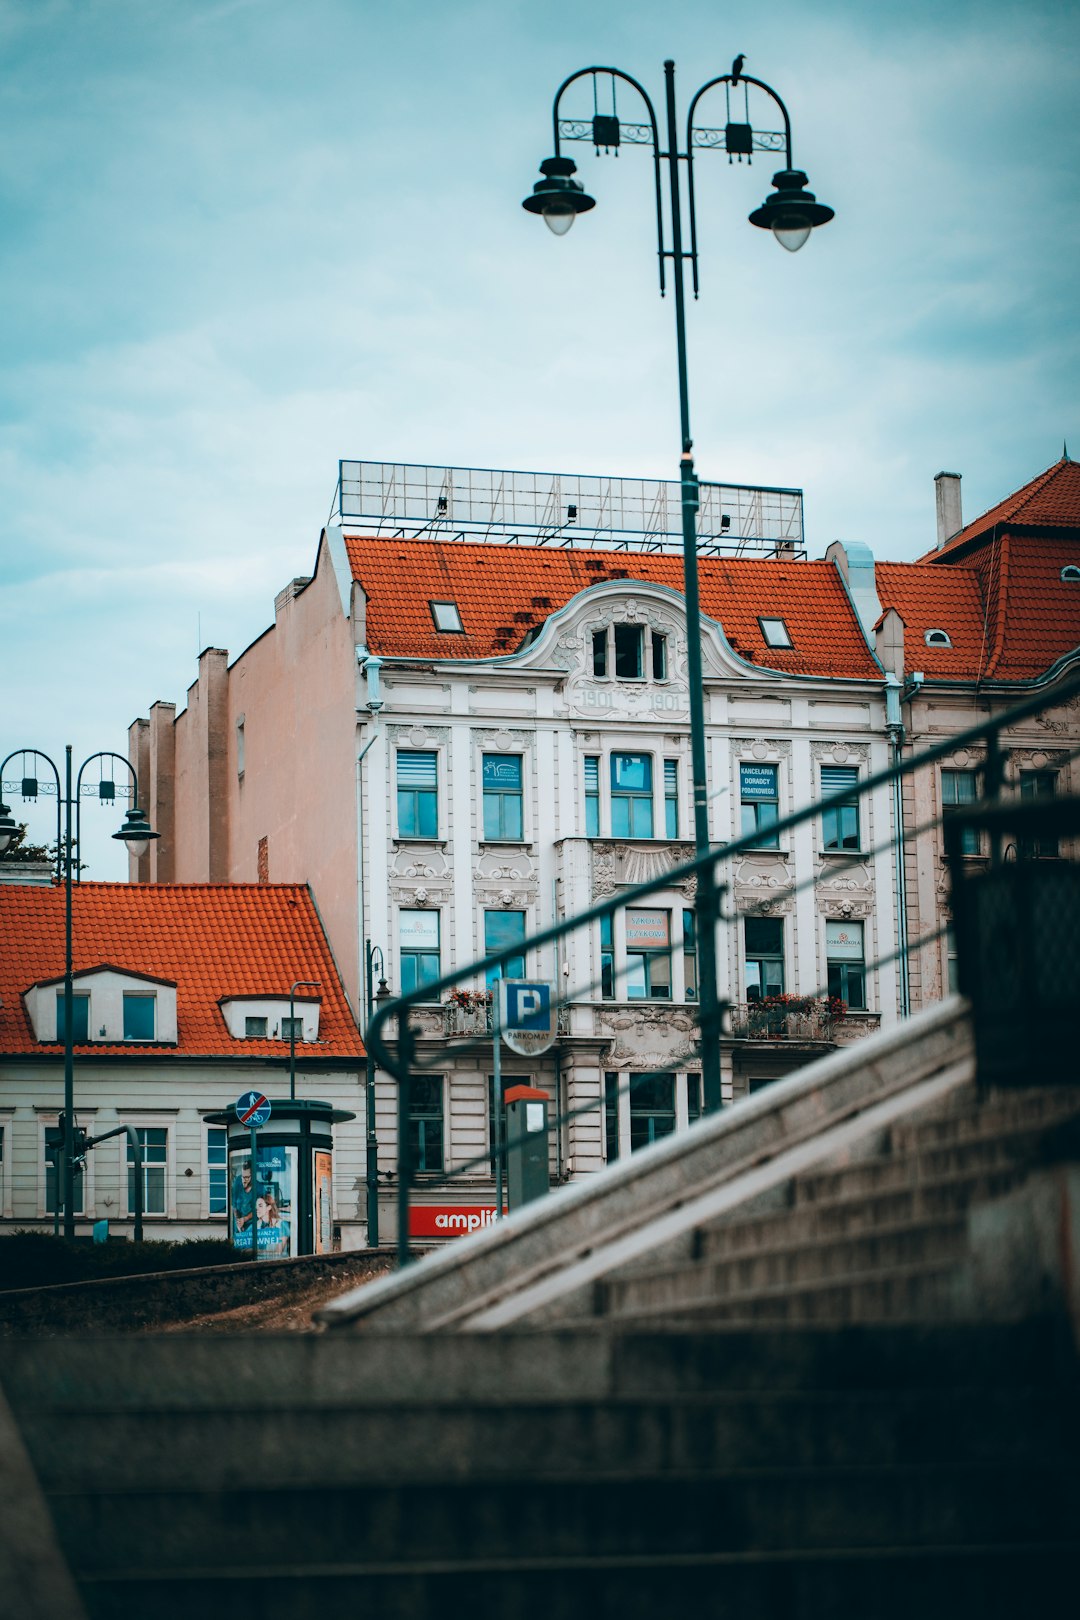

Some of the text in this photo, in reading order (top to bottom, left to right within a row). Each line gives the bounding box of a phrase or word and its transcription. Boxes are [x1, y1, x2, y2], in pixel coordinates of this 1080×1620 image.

[582, 690, 613, 706] 1901
[651, 694, 679, 710] 1901
[741, 768, 774, 776] KANCELARIA
[744, 777, 771, 785] DORADCY
[741, 787, 775, 795] PODATKOWEGO
[517, 989, 541, 1024] P
[508, 1032, 550, 1040] PARKOMAT
[435, 1209, 508, 1233] amplif
